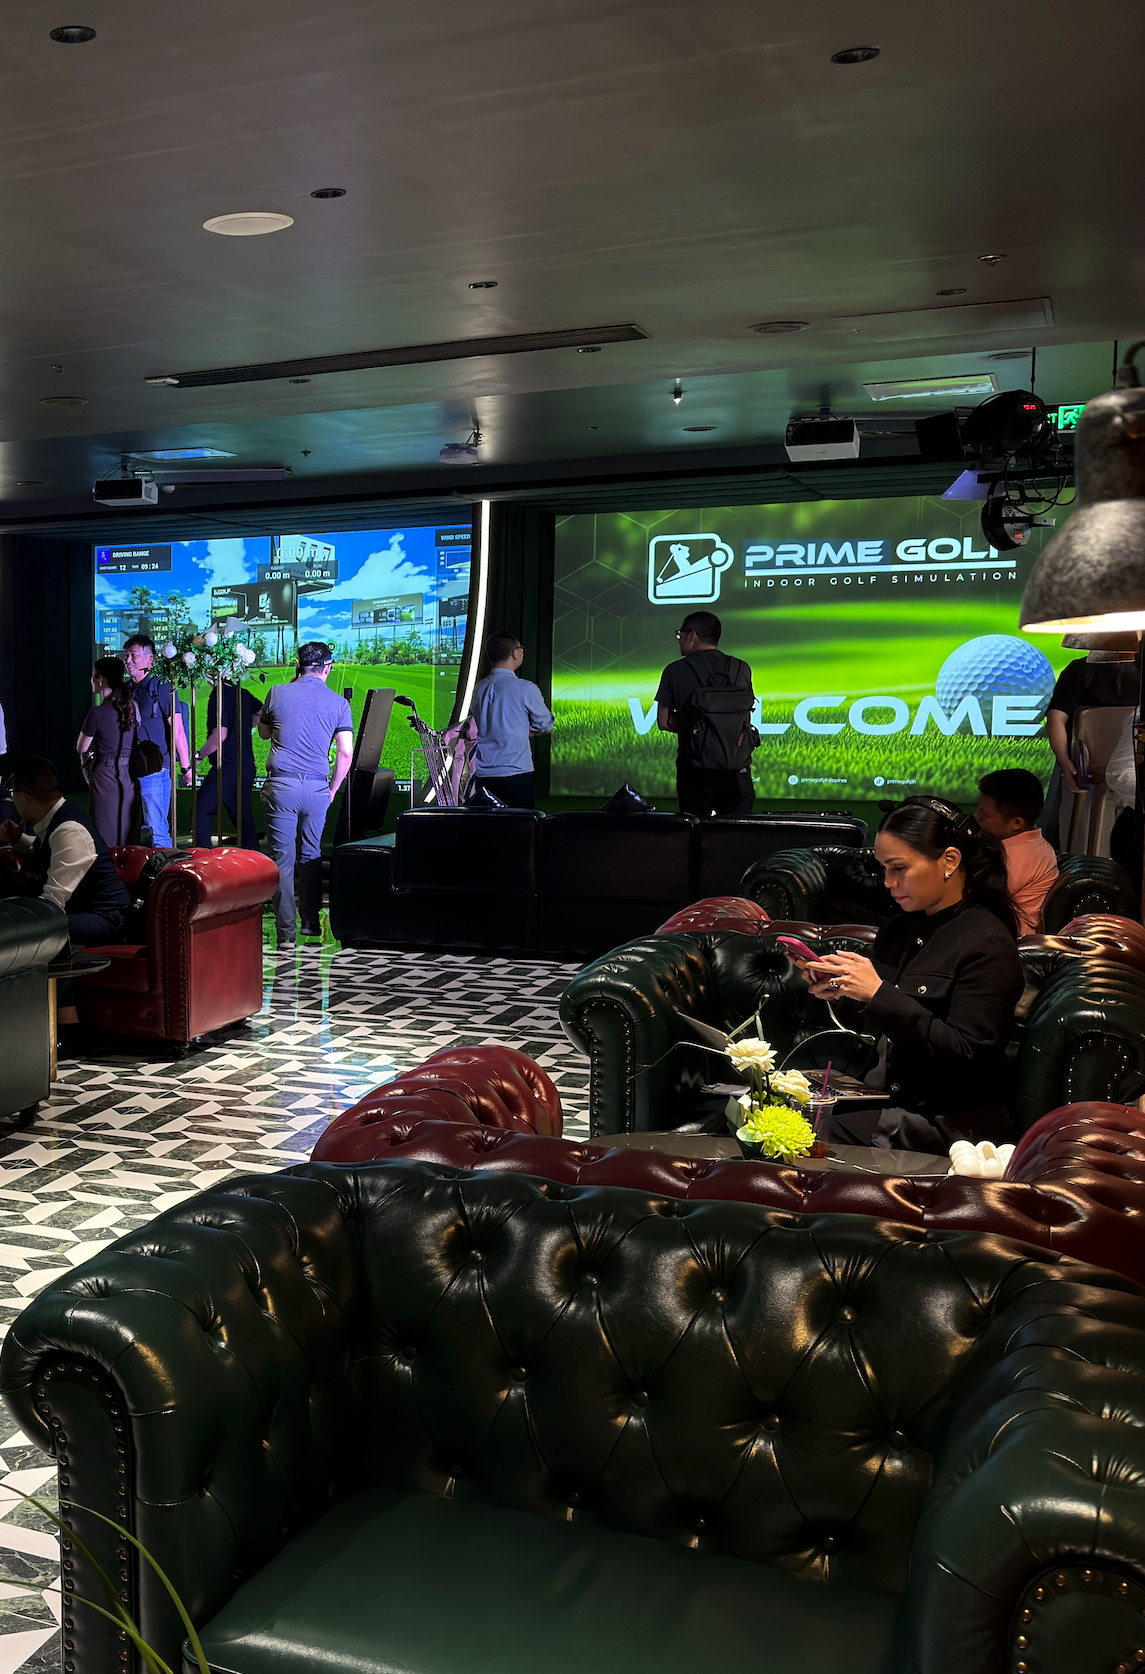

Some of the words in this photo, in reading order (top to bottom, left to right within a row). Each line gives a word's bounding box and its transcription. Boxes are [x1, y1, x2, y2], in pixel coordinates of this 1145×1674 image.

[745, 539, 885, 567] PRIME
[265, 572, 281, 580] 0.00
[305, 570, 321, 578] 0.00
[744, 578, 816, 588] INDOOR
[830, 576, 878, 586] GOLF
[891, 572, 1017, 584] SIMULATION
[627, 694, 1046, 736] LCOME
